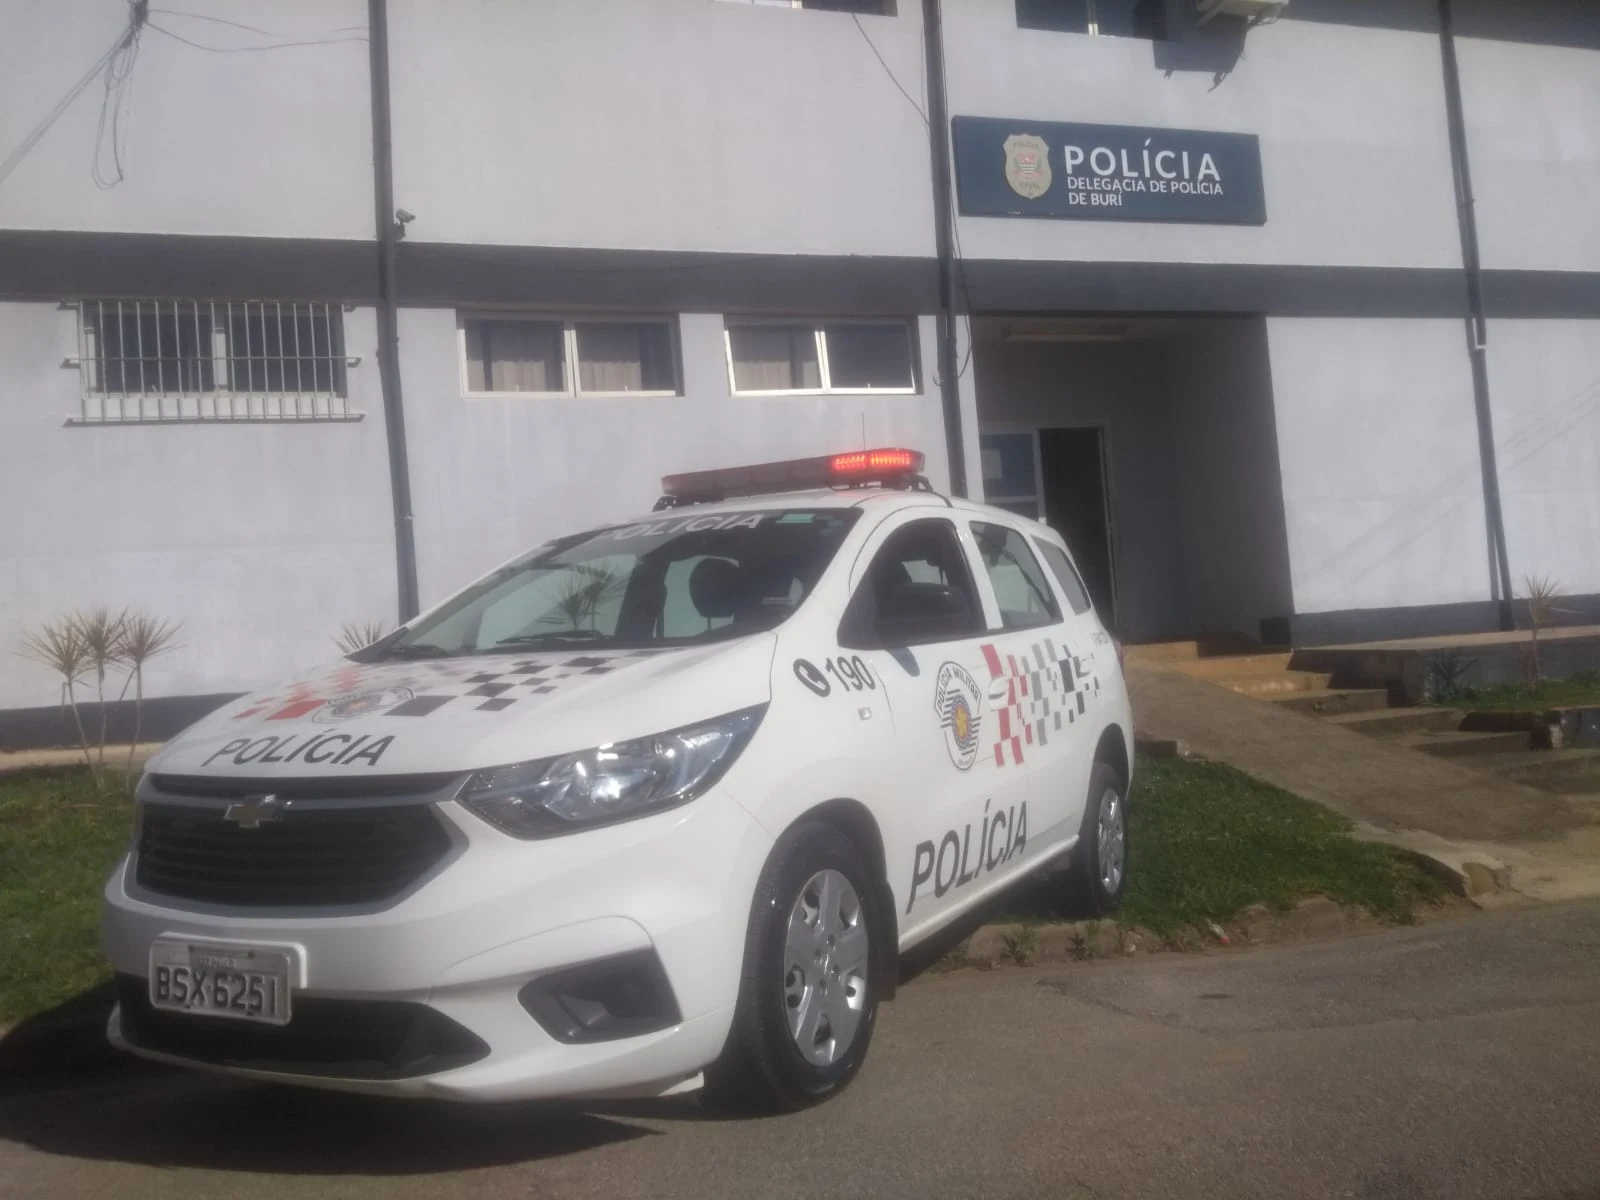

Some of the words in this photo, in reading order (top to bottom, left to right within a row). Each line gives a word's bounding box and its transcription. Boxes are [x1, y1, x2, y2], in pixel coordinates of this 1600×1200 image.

[1064, 137, 1221, 181] POLÍCIA
[1068, 176, 1145, 192] DELEGACIA
[1150, 181, 1167, 193] DE
[1069, 192, 1087, 205] DE
[825, 655, 876, 692] 190
[201, 728, 395, 767] POLÍCIA
[906, 798, 1027, 915] POLÍCIA
